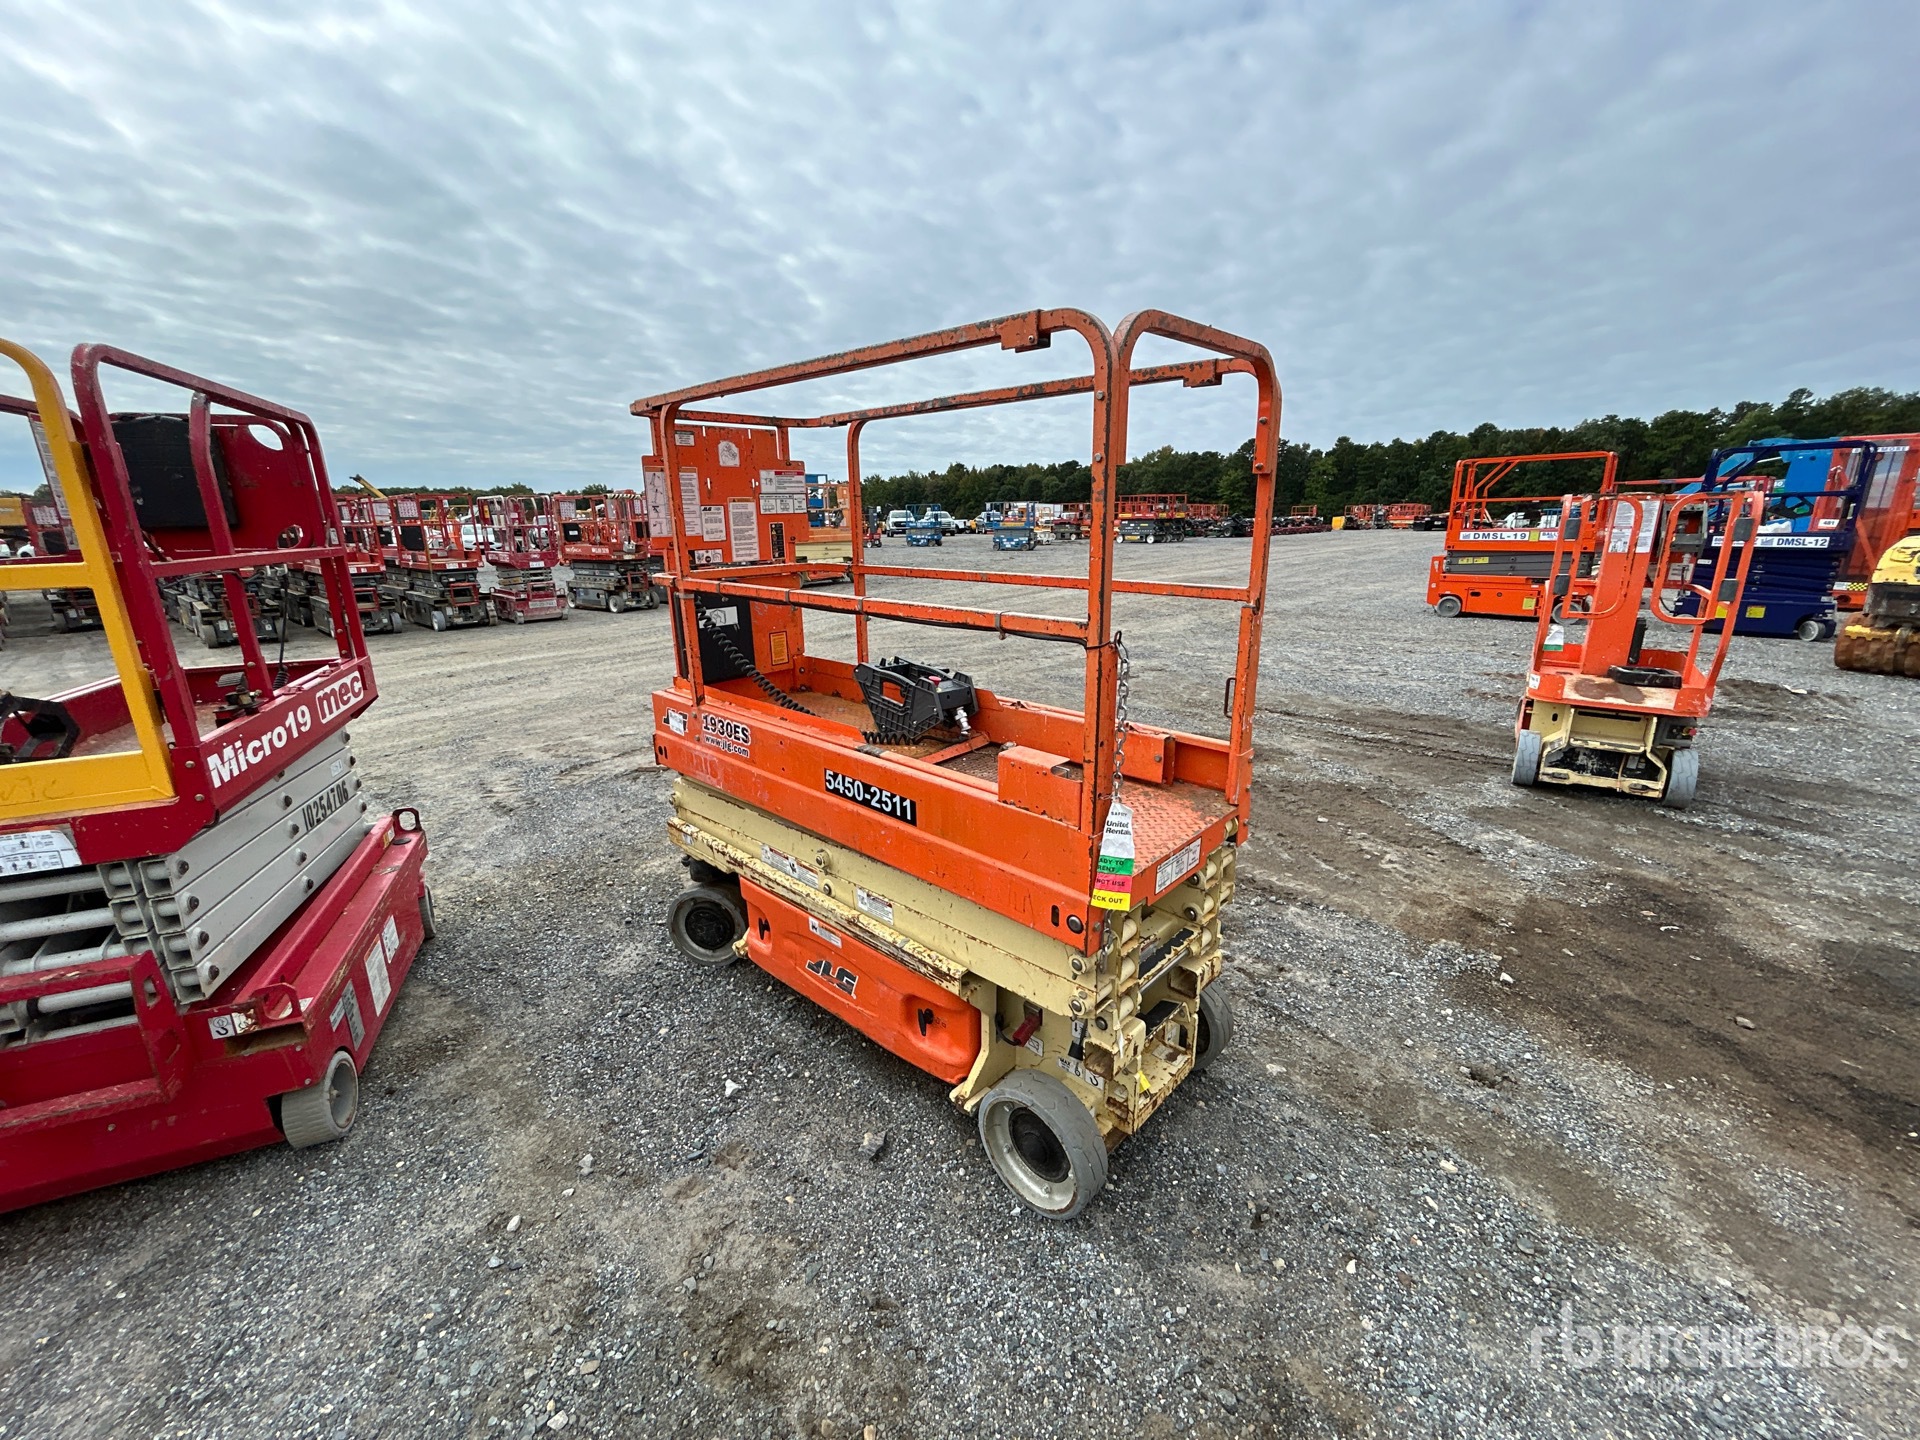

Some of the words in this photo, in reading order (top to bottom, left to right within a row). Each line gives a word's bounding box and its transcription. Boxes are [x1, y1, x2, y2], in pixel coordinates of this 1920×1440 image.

[1473, 532, 1527, 540] DMSL-19
[1776, 538, 1828, 547] DMSL-12
[318, 675, 363, 721] mec
[702, 714, 750, 744] 1930ES
[207, 705, 312, 788] Micro19
[704, 735, 749, 758] www.jlg.com
[825, 769, 912, 821] 5450-2511
[1092, 894, 1107, 902] ECK
[1108, 897, 1124, 905] OUT
